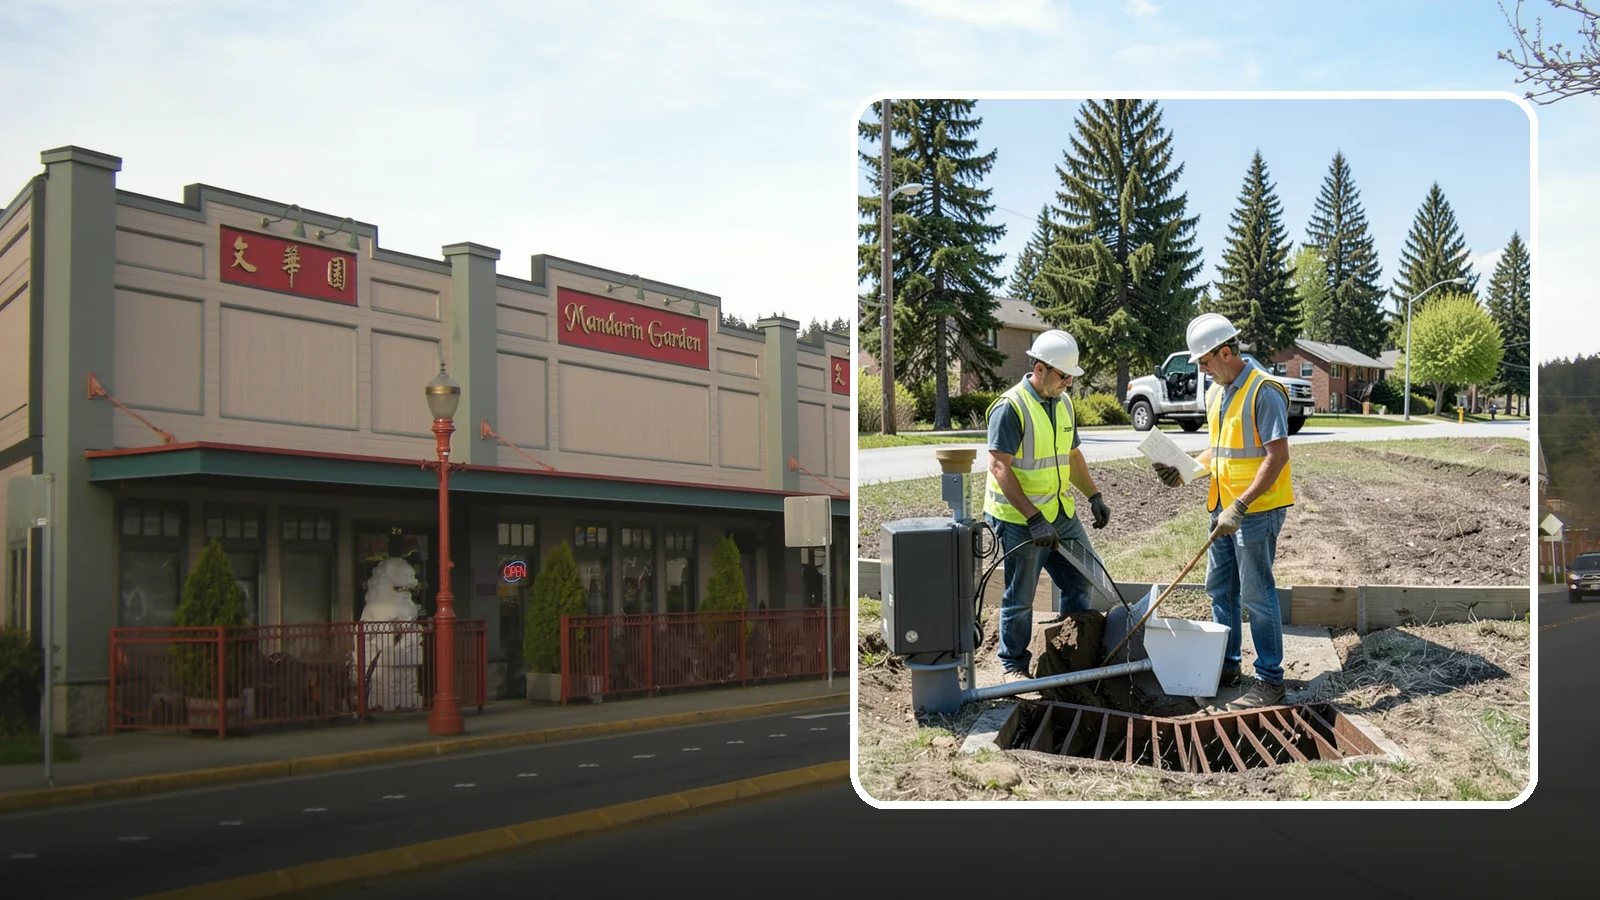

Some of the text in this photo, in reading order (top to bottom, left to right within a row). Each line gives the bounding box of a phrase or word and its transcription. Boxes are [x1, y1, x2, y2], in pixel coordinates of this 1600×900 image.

[564, 302, 701, 352] Mandarin Garden
[504, 566, 526, 578] OPEN
